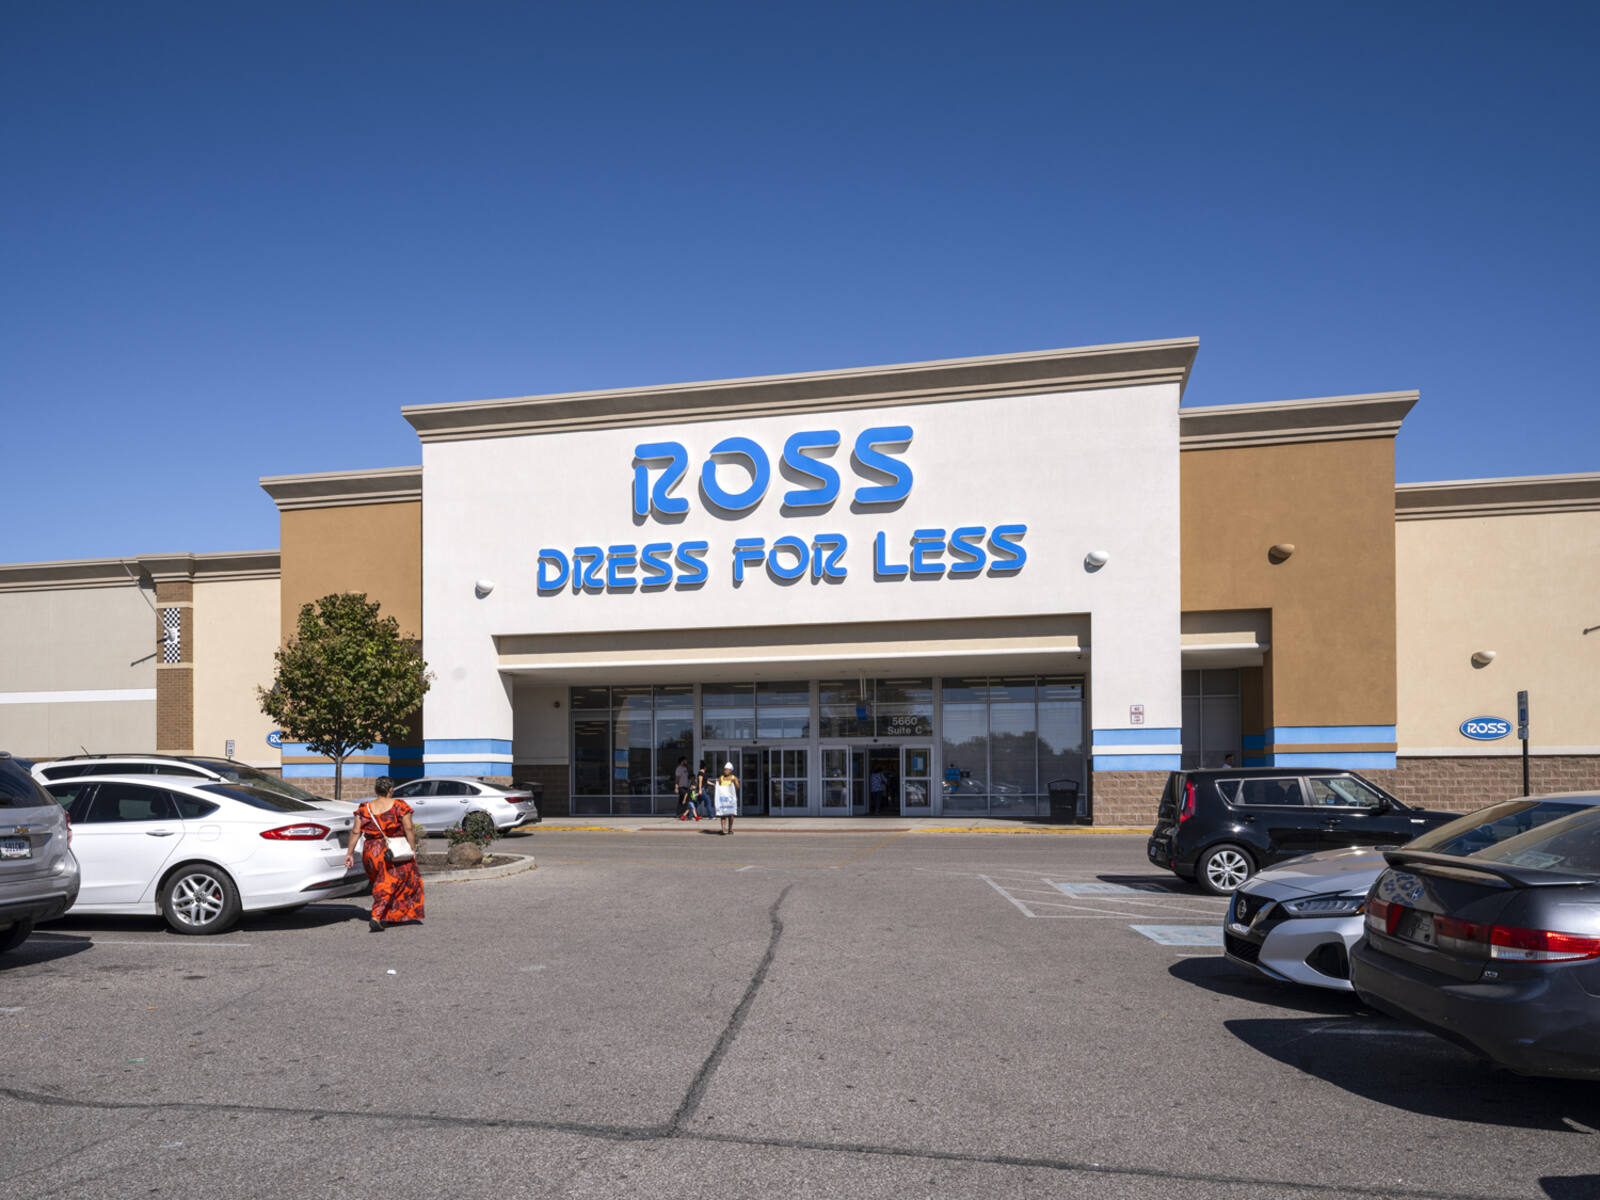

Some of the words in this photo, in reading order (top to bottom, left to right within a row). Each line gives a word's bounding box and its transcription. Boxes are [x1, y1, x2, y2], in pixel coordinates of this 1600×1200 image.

[634, 425, 914, 516] ROSS
[538, 540, 709, 592] DRESS
[733, 534, 848, 584] FOR
[875, 524, 1028, 577] LESS
[892, 716, 918, 726] 5660
[888, 726, 912, 735] Suite
[915, 726, 922, 735] C
[1467, 722, 1507, 734] ROSS
